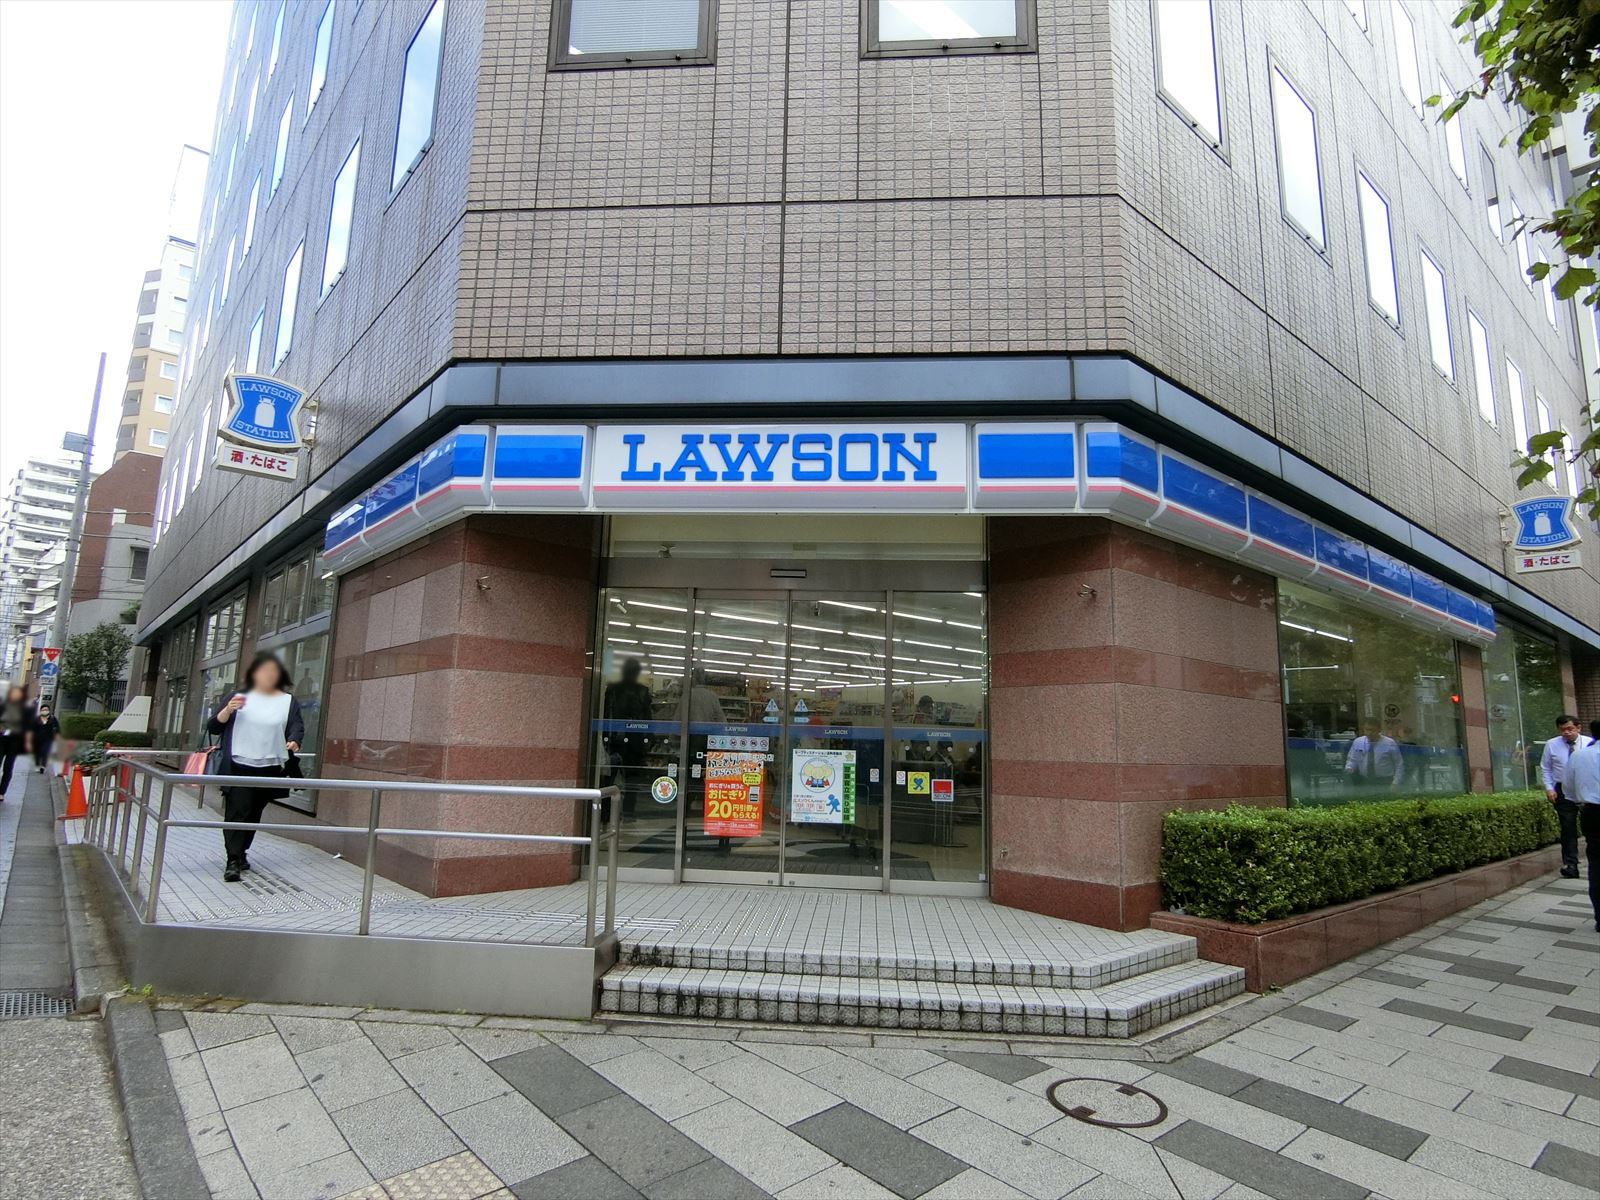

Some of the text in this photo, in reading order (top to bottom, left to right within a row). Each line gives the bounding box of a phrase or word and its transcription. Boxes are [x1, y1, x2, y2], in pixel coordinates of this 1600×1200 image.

[241, 382, 296, 403] LAWSON
[235, 420, 290, 439] STATION
[621, 432, 937, 481] LAWSON
[1518, 502, 1564, 515] LAWSON
[1521, 531, 1567, 543] STATION
[708, 789, 747, 800] おにぎり
[708, 800, 733, 819] 20
